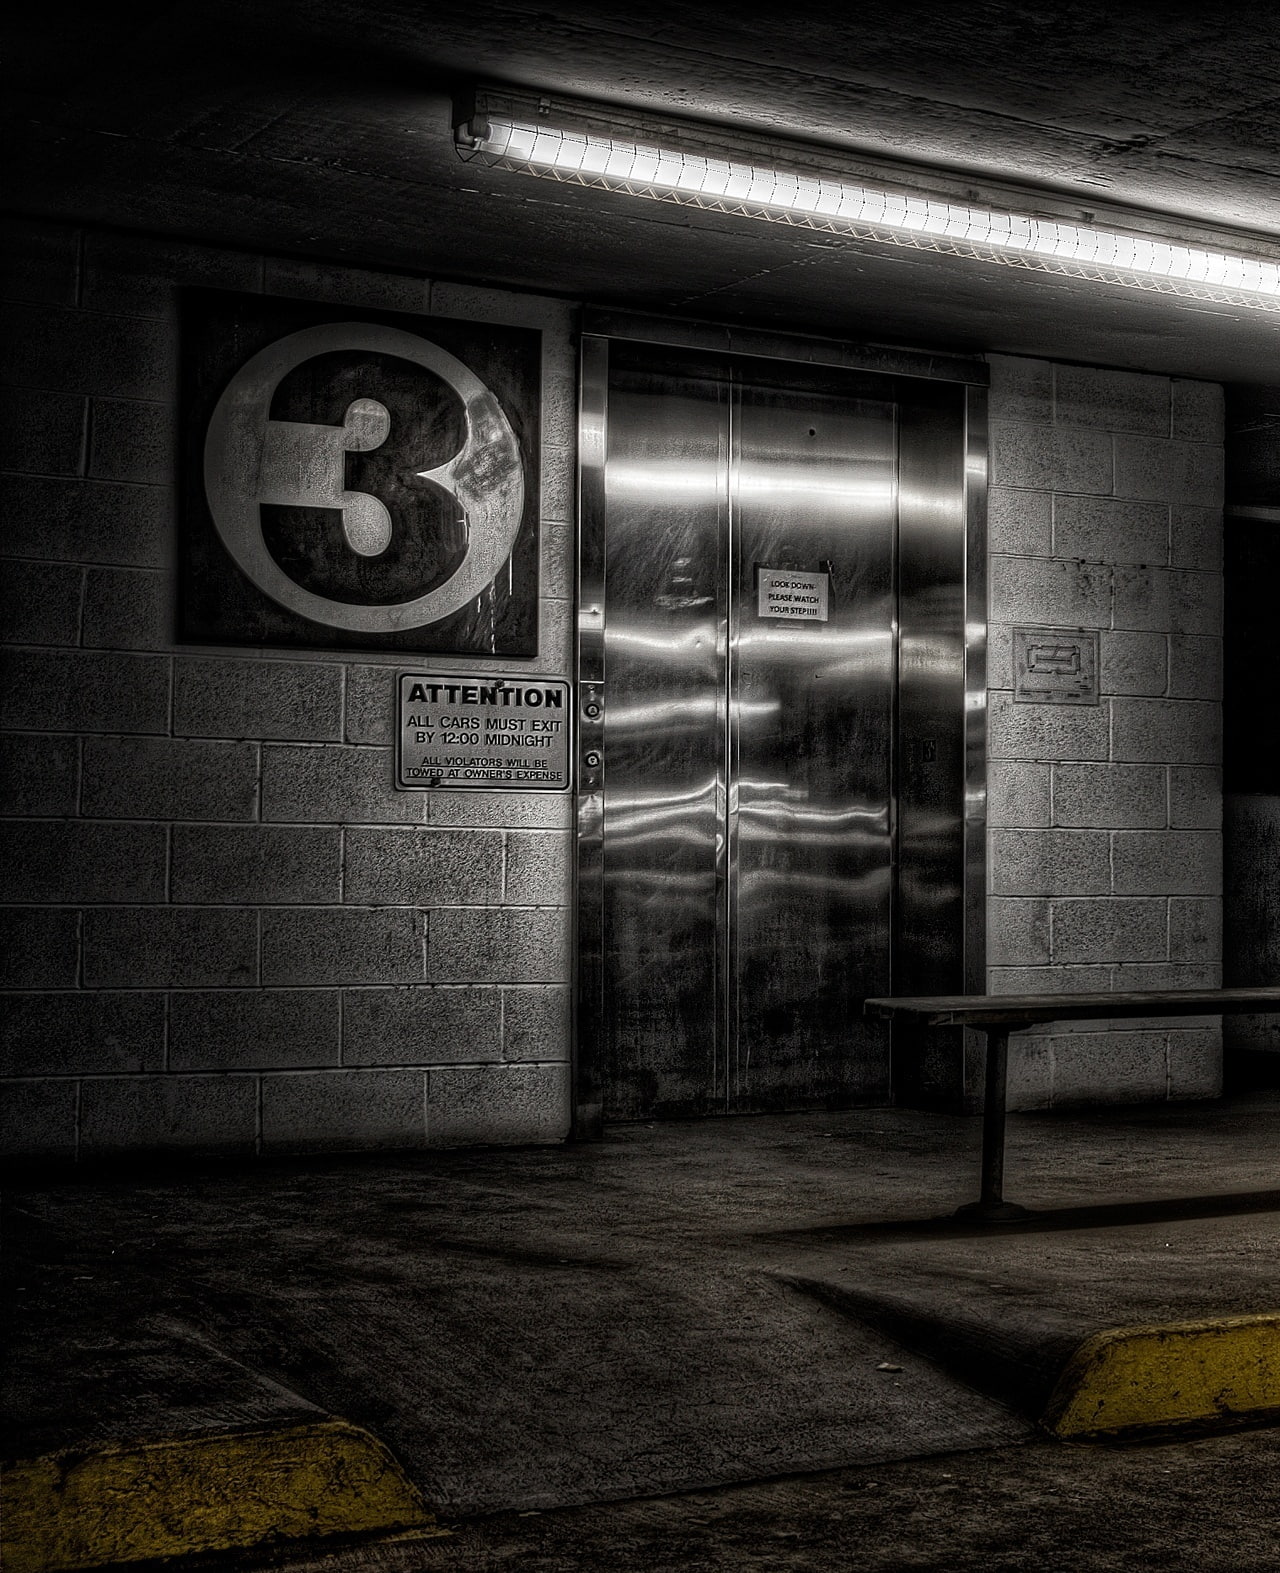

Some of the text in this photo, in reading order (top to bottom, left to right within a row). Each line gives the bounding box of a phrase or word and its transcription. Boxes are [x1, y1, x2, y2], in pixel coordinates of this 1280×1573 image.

[259, 349, 470, 607] 3
[768, 593, 819, 604] PLEASE WATCH
[407, 683, 562, 708] ATTENTION
[407, 715, 562, 732] ALL CARS MUST EXIT
[416, 731, 553, 748] BY 12:00 MIDNIGHT
[422, 757, 548, 768] ALL VIOLATORS WILL BE
[407, 767, 562, 780] TOWED AT OWNER'S EXPENSE
